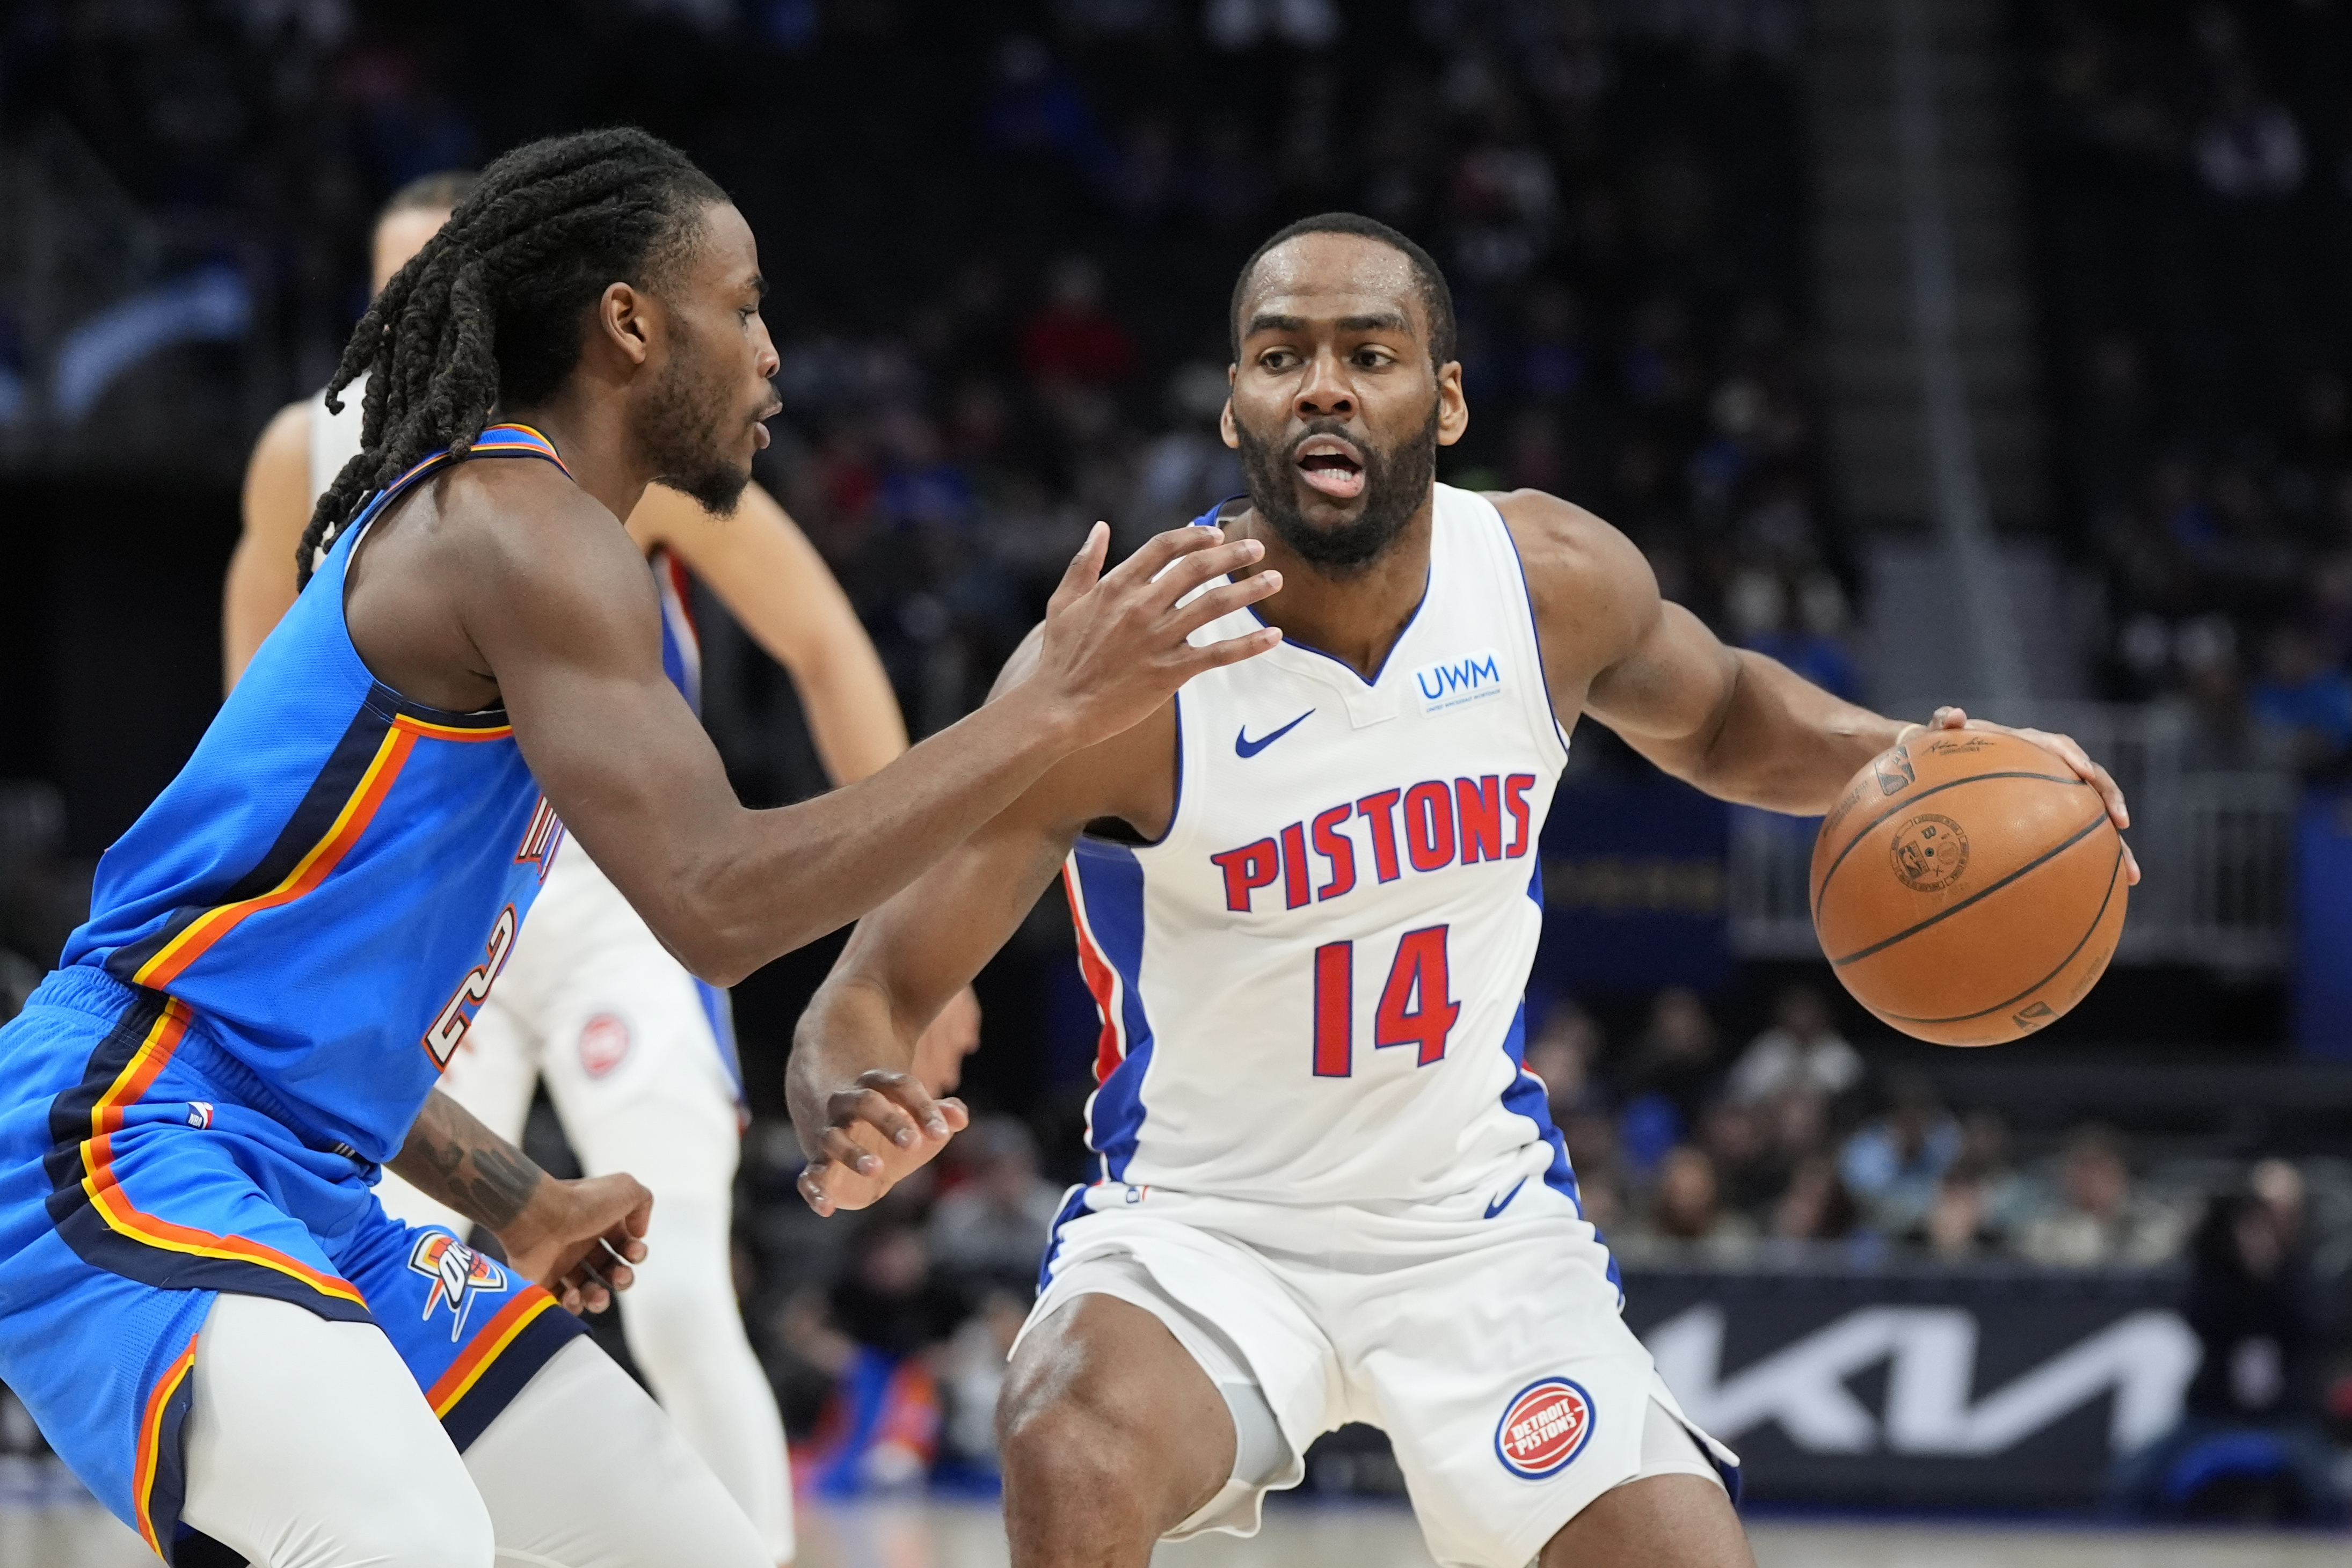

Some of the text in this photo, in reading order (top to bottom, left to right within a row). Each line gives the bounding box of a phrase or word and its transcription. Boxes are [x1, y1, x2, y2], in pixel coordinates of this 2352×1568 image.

[1417, 654, 1499, 699] UWM
[1210, 773, 1535, 913] PISTONS
[1313, 923, 1461, 1078] 14
[188, 1113, 202, 1127] NBA
[1510, 1398, 1570, 1441] DETROIT
[1514, 1412, 1577, 1456] PISTONS
